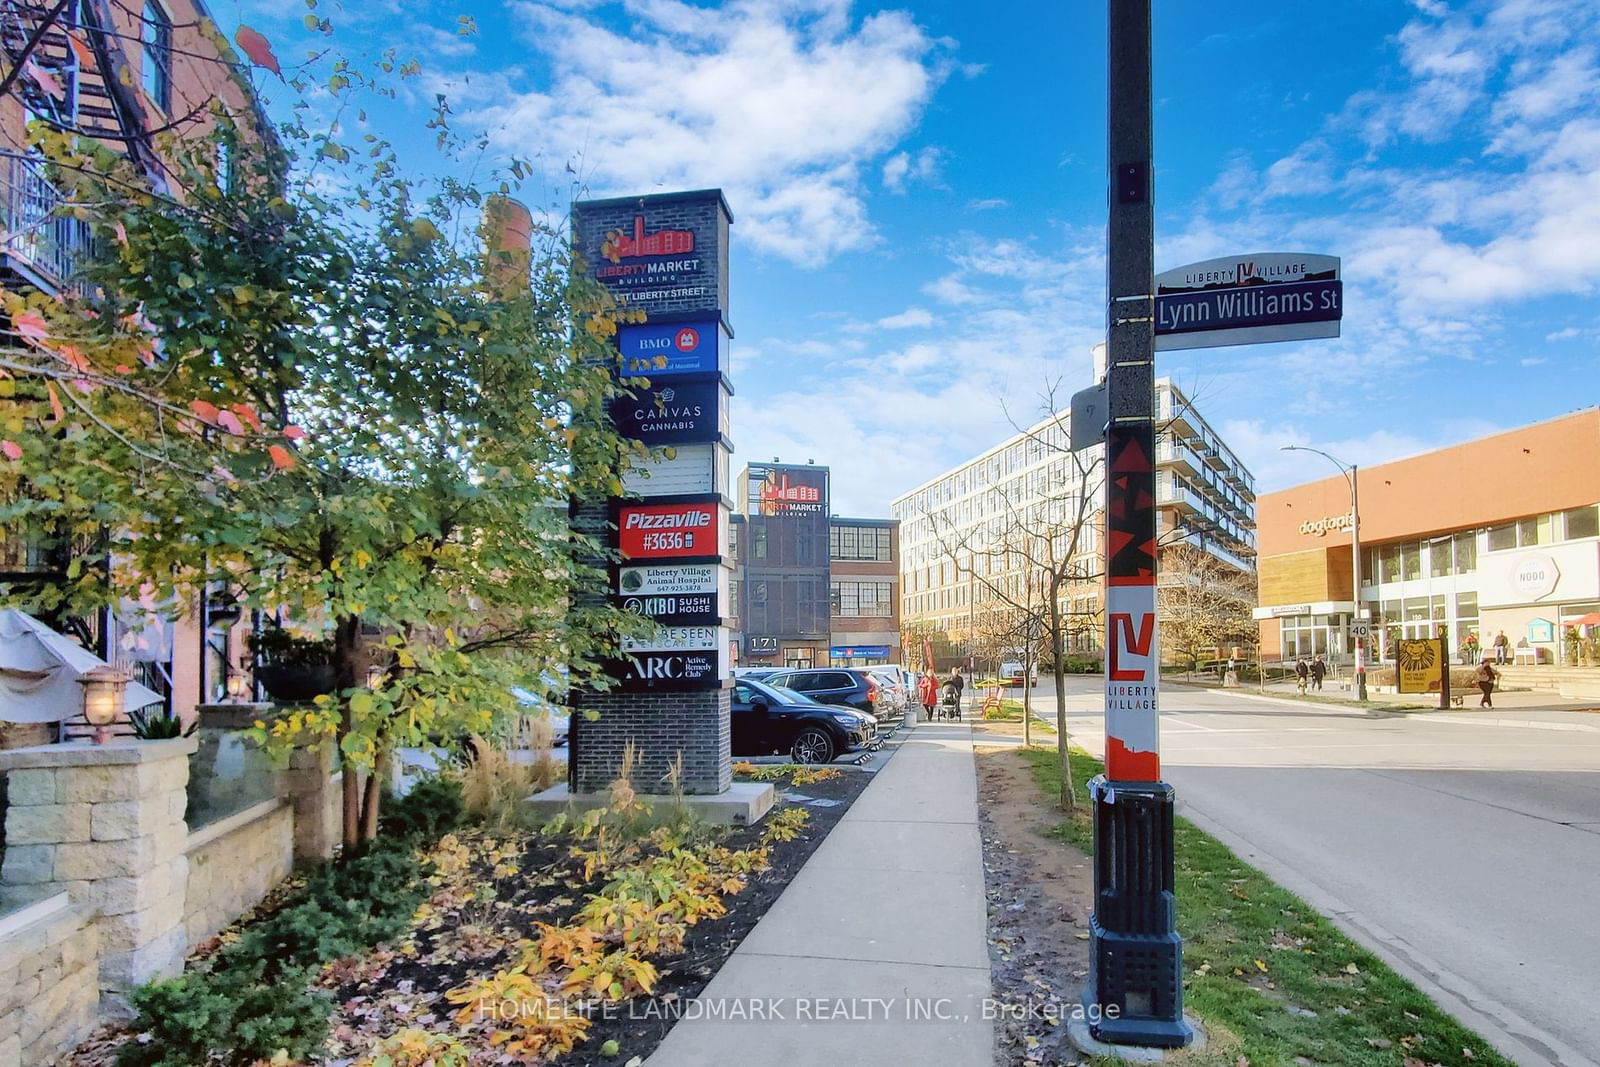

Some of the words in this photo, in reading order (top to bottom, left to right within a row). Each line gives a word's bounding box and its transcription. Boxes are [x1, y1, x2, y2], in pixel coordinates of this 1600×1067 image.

[1186, 269, 1234, 283] LIBERTY
[1257, 263, 1306, 277] VILLAGE
[618, 274, 676, 285] BUILDING
[632, 290, 671, 301] LIBERTY
[671, 287, 705, 298] STREET
[1159, 300, 1210, 330] Lynn
[1216, 290, 1314, 319] Williams
[1320, 289, 1338, 310] St
[639, 337, 671, 350] BMO
[634, 406, 702, 420] CANVAS
[641, 421, 694, 432] CANNABIS
[625, 511, 711, 530] Pizzaville
[643, 531, 683, 551] #3636
[646, 569, 679, 578] Liberty
[681, 567, 711, 577] Village
[646, 577, 675, 585] Animal
[677, 576, 711, 585] Hospital
[645, 598, 676, 615] KIBO
[679, 597, 710, 606] SUSHI
[679, 605, 710, 613] HOUSE
[682, 628, 714, 639] SEEN
[1352, 626, 1367, 636] 40
[751, 638, 777, 647] 171
[685, 656, 706, 664] Active
[625, 657, 683, 679] ARC
[685, 663, 712, 672] Remedy
[685, 670, 701, 678] Club
[1108, 686, 1156, 697] LIBERTY
[1108, 700, 1156, 710] VILLAGE
